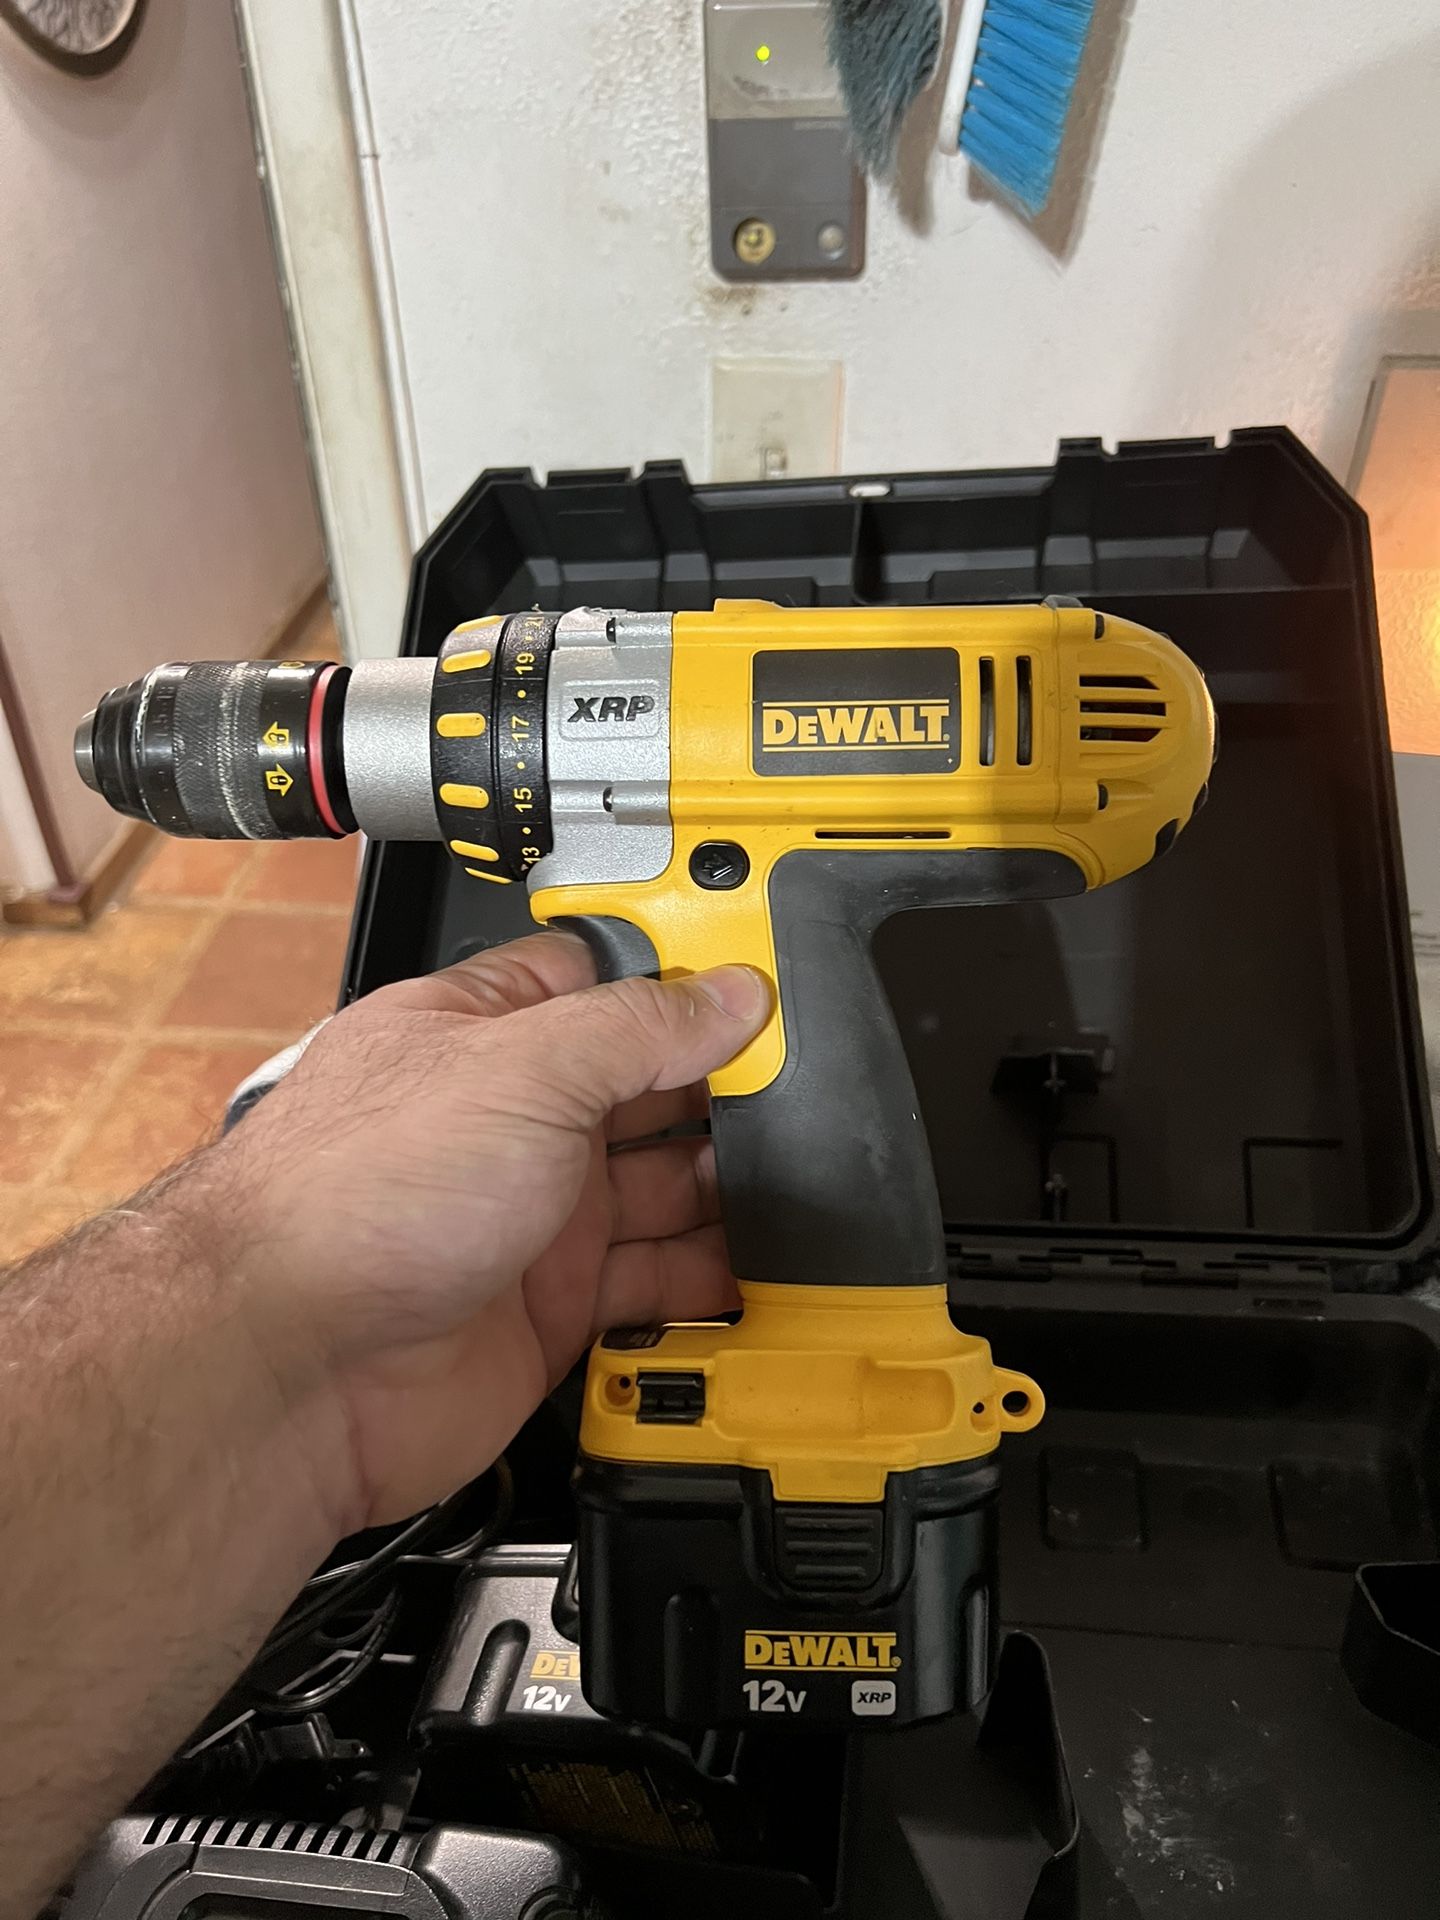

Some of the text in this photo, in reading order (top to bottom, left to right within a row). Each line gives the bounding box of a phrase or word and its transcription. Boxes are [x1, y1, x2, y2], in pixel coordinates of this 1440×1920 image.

[517, 651, 535, 675] 19
[567, 695, 655, 722] XRP
[512, 715, 530, 741] 17
[514, 787, 532, 812] 15
[522, 846, 541, 865] 13
[857, 1691, 891, 1703] XRP
